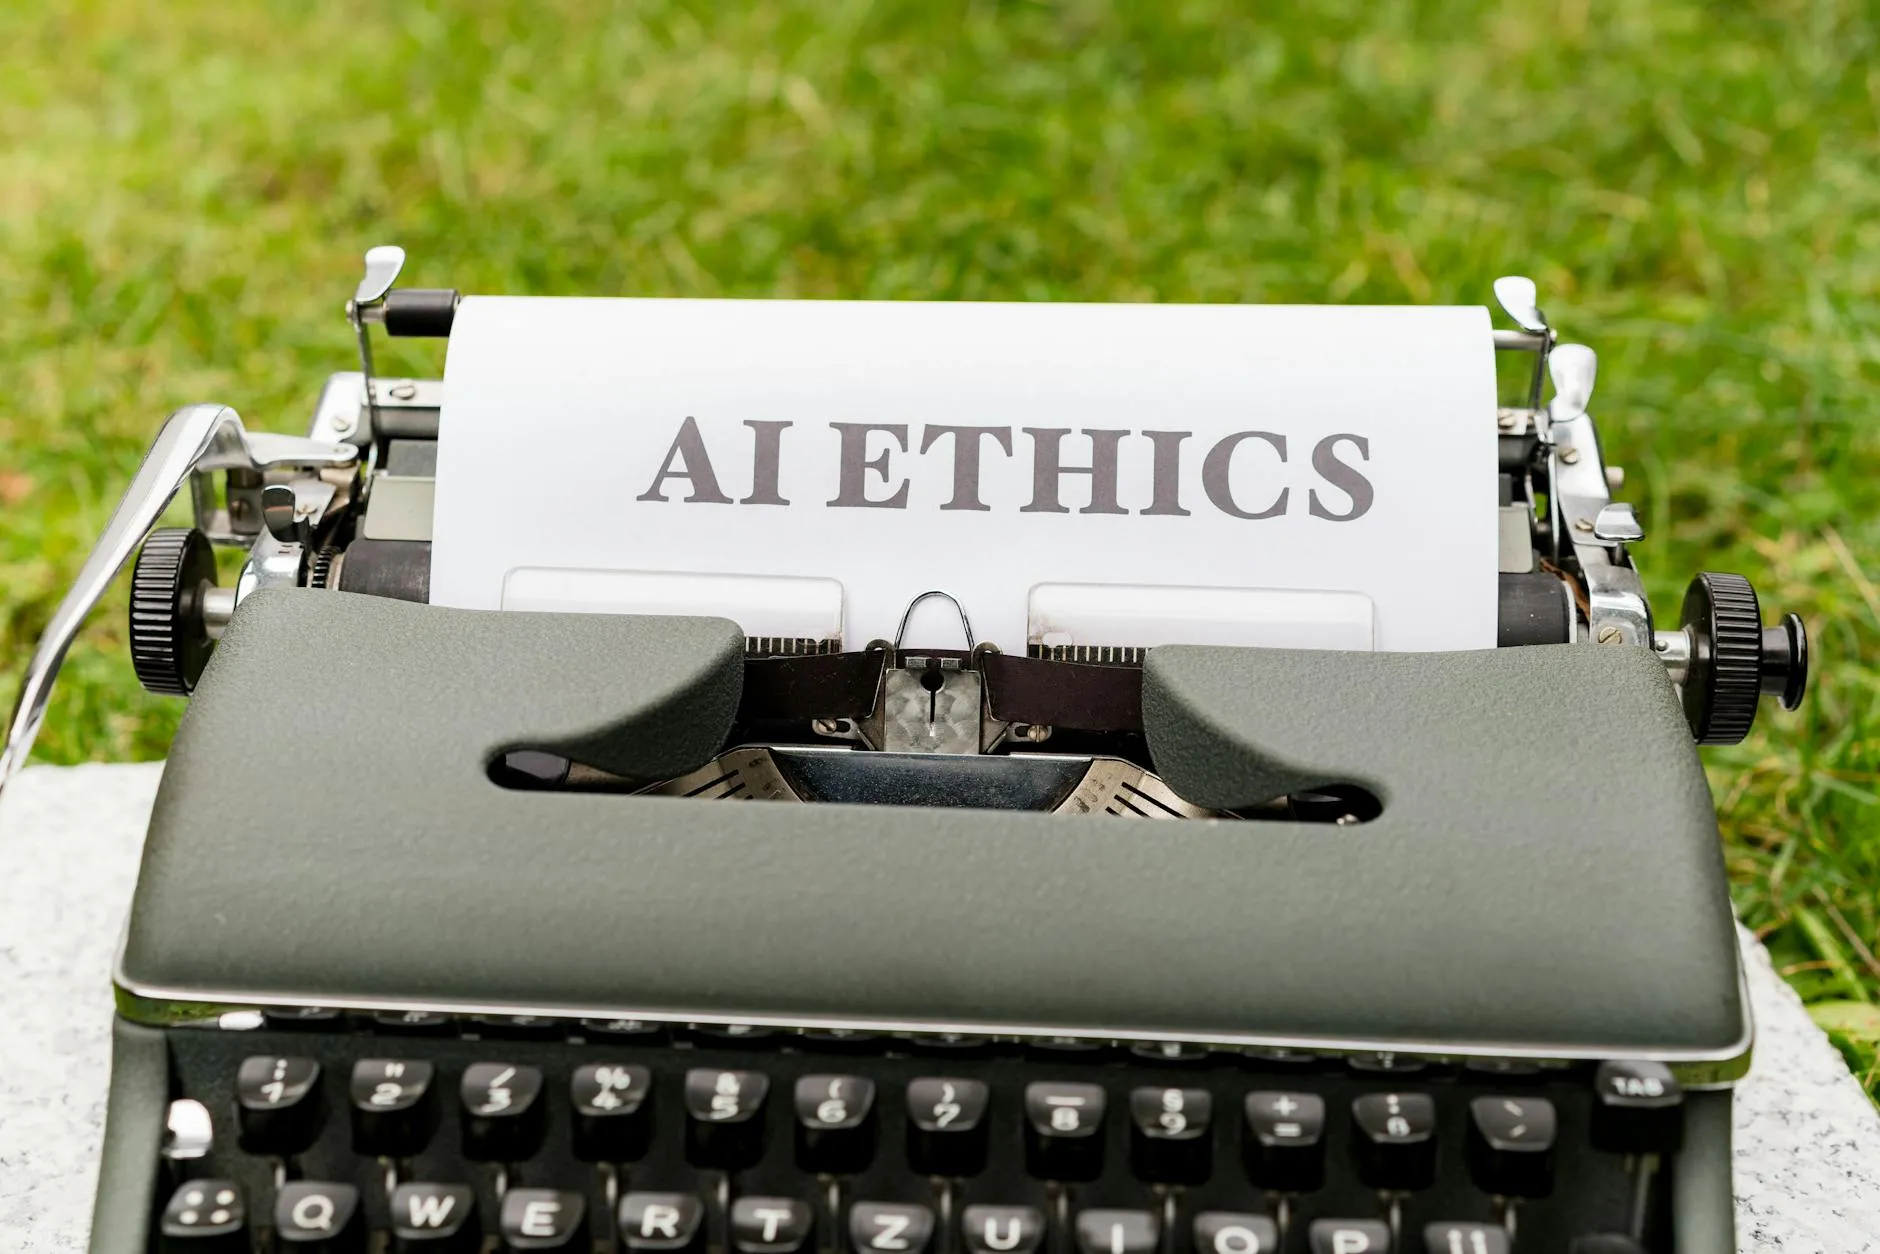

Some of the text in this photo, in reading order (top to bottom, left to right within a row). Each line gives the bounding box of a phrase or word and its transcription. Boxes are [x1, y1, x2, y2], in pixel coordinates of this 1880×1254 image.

[636, 415, 1374, 522] AI ETHICS
[370, 1082, 403, 1105] 2
[1611, 1075, 1665, 1097] TAB
[482, 1088, 512, 1113] 3
[711, 1095, 739, 1120] 5
[817, 1099, 847, 1123] 6
[932, 1102, 961, 1128] 7
[1051, 1106, 1080, 1131] 8
[1159, 1111, 1187, 1136] 9
[292, 1194, 333, 1231] Q
[408, 1194, 455, 1227] W
[521, 1201, 562, 1236] E
[640, 1204, 680, 1238] R
[753, 1208, 792, 1242] T
[872, 1214, 910, 1249] Z
[984, 1217, 1022, 1250] U
[1111, 1223, 1124, 1254] I
[1214, 1226, 1260, 1254] O
[1333, 1229, 1369, 1254] P
